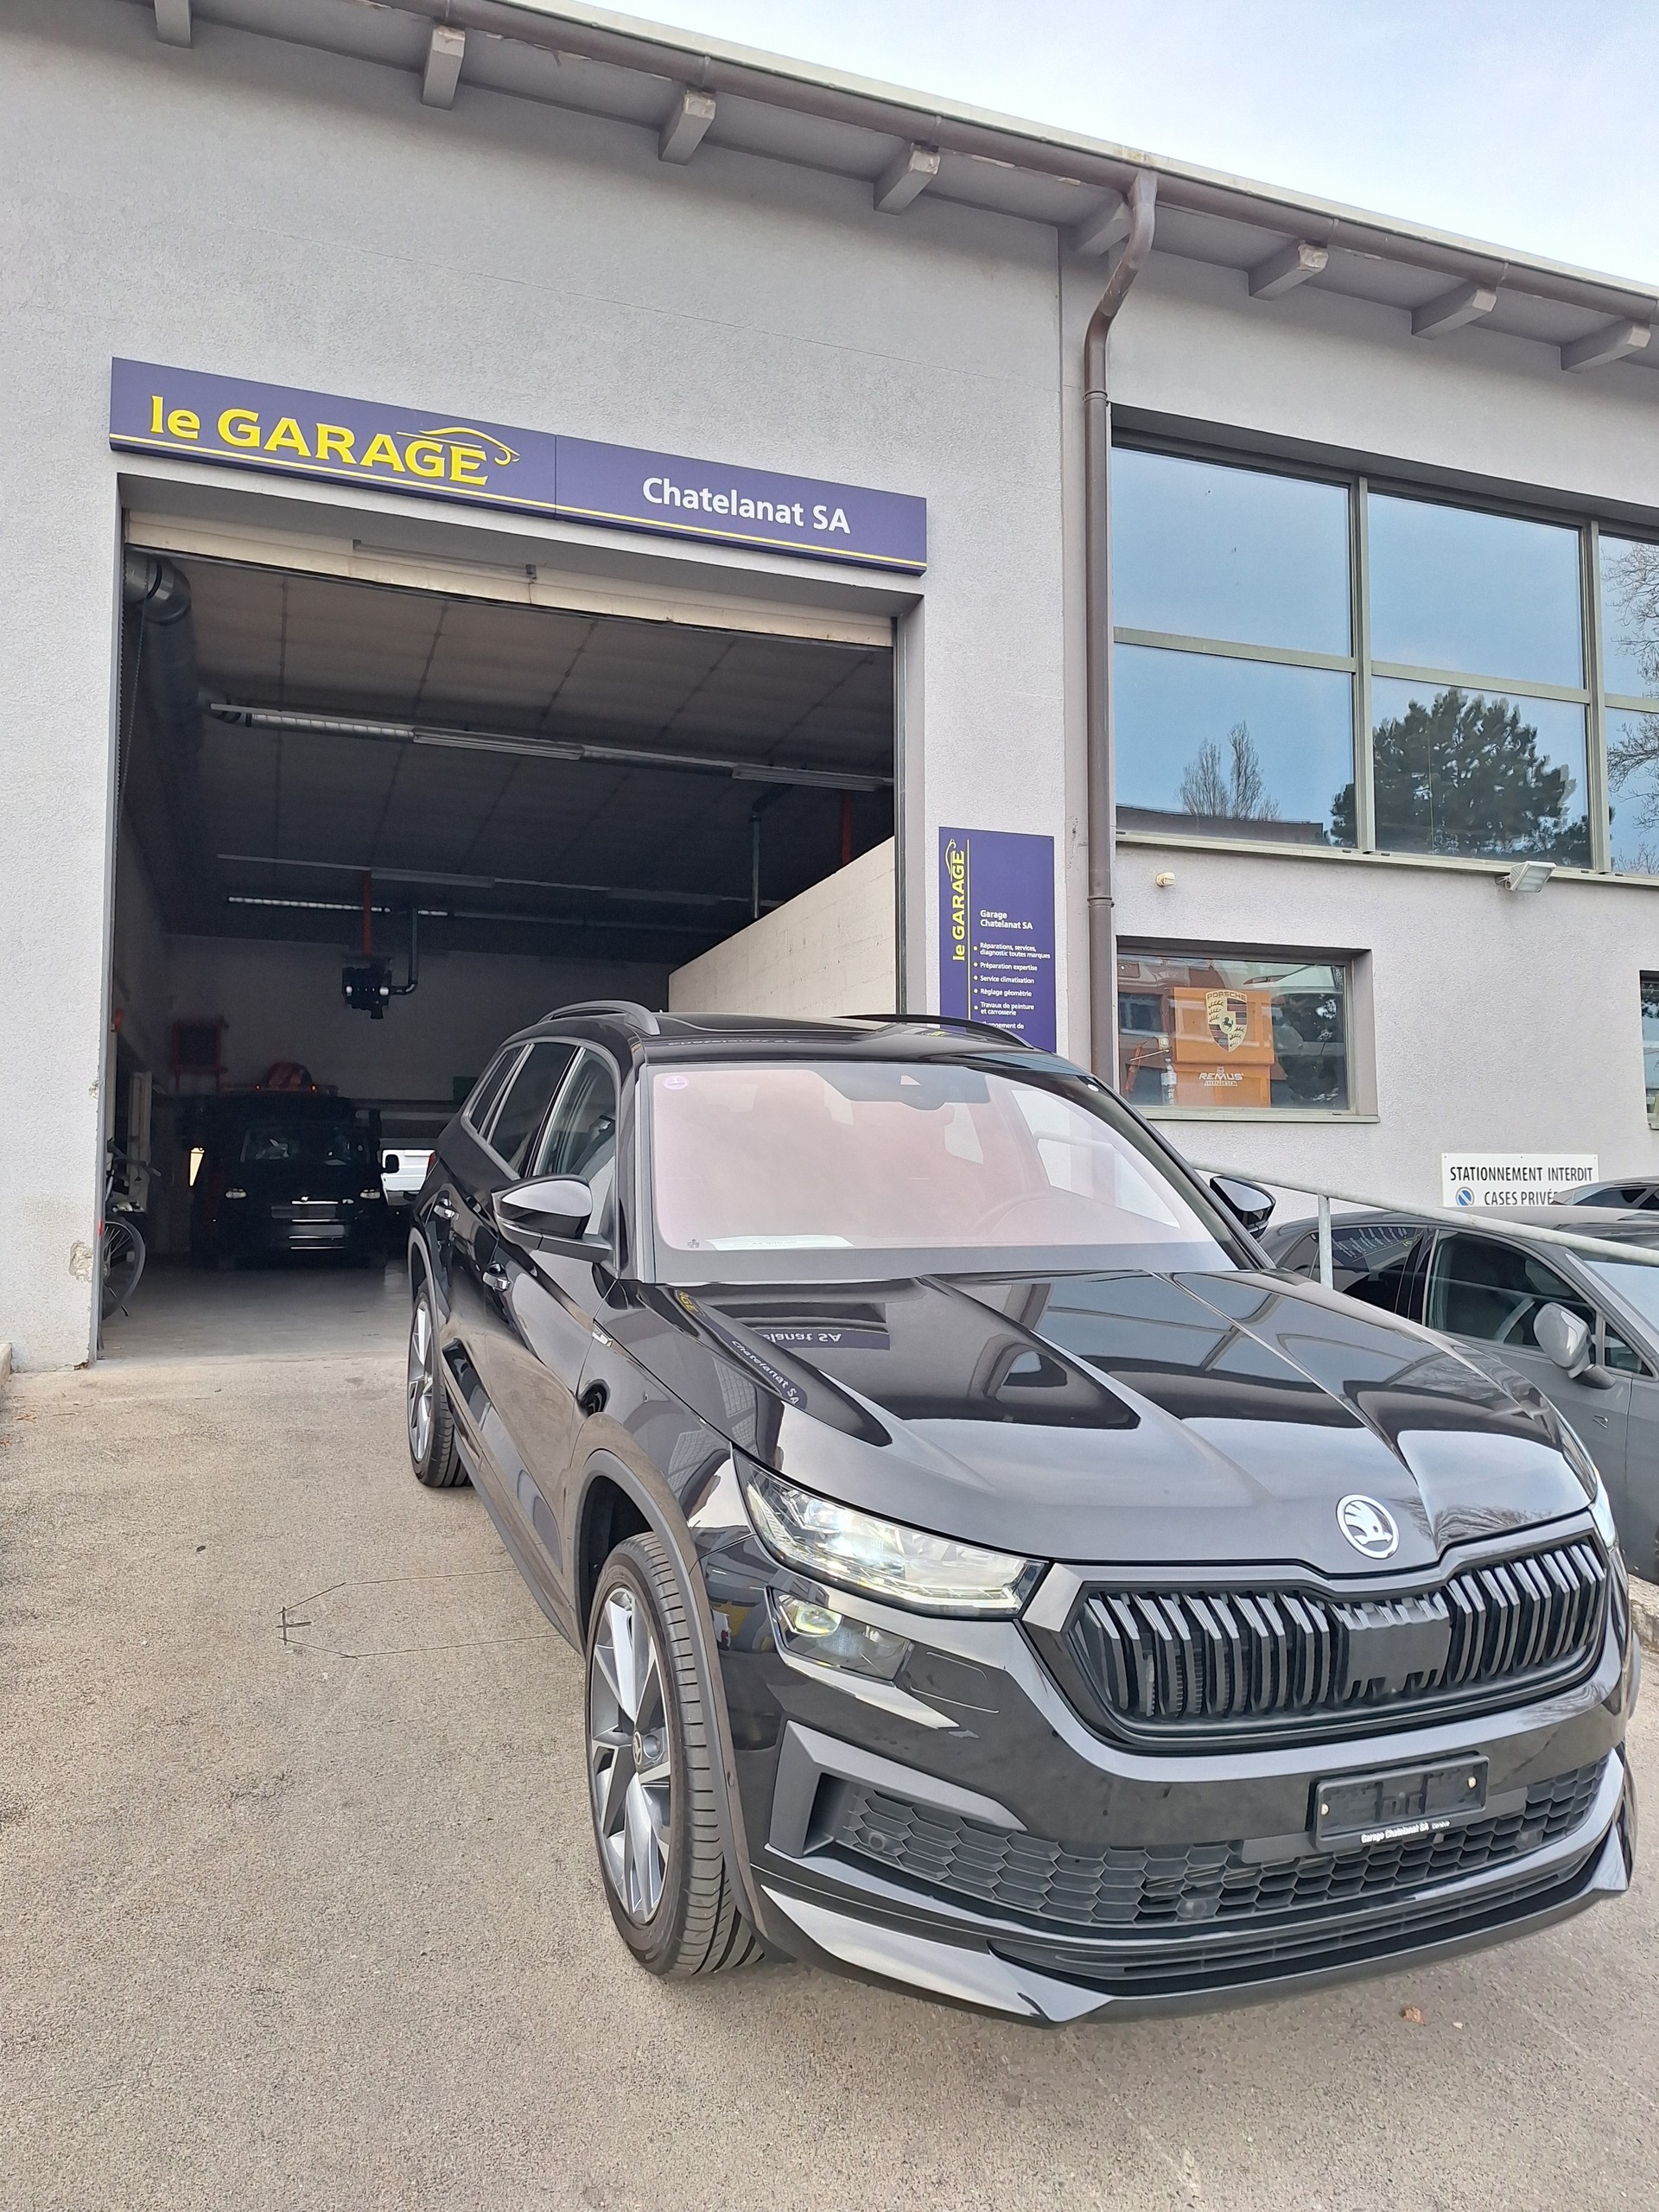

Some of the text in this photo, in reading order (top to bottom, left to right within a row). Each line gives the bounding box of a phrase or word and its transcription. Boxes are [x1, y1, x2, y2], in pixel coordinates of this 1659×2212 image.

[150, 395, 488, 486] le GARAGE
[642, 477, 851, 535] Chatelanat SA
[951, 850, 965, 961] le GARAGE
[980, 910, 1007, 919] Garage
[980, 918, 1021, 929] Chatelanat
[980, 962, 1013, 970] Préparation
[1207, 991, 1247, 1001] PORSCHE
[1012, 1003, 1034, 1012] peinture
[1198, 1072, 1243, 1081] REMUS
[1450, 1166, 1593, 1181] STATIONNEMENT INTERDIT
[1484, 1188, 1558, 1205] CASES PRIVÉ
[1361, 1833, 1384, 1843] Garage
[1420, 1821, 1429, 1832] SA
